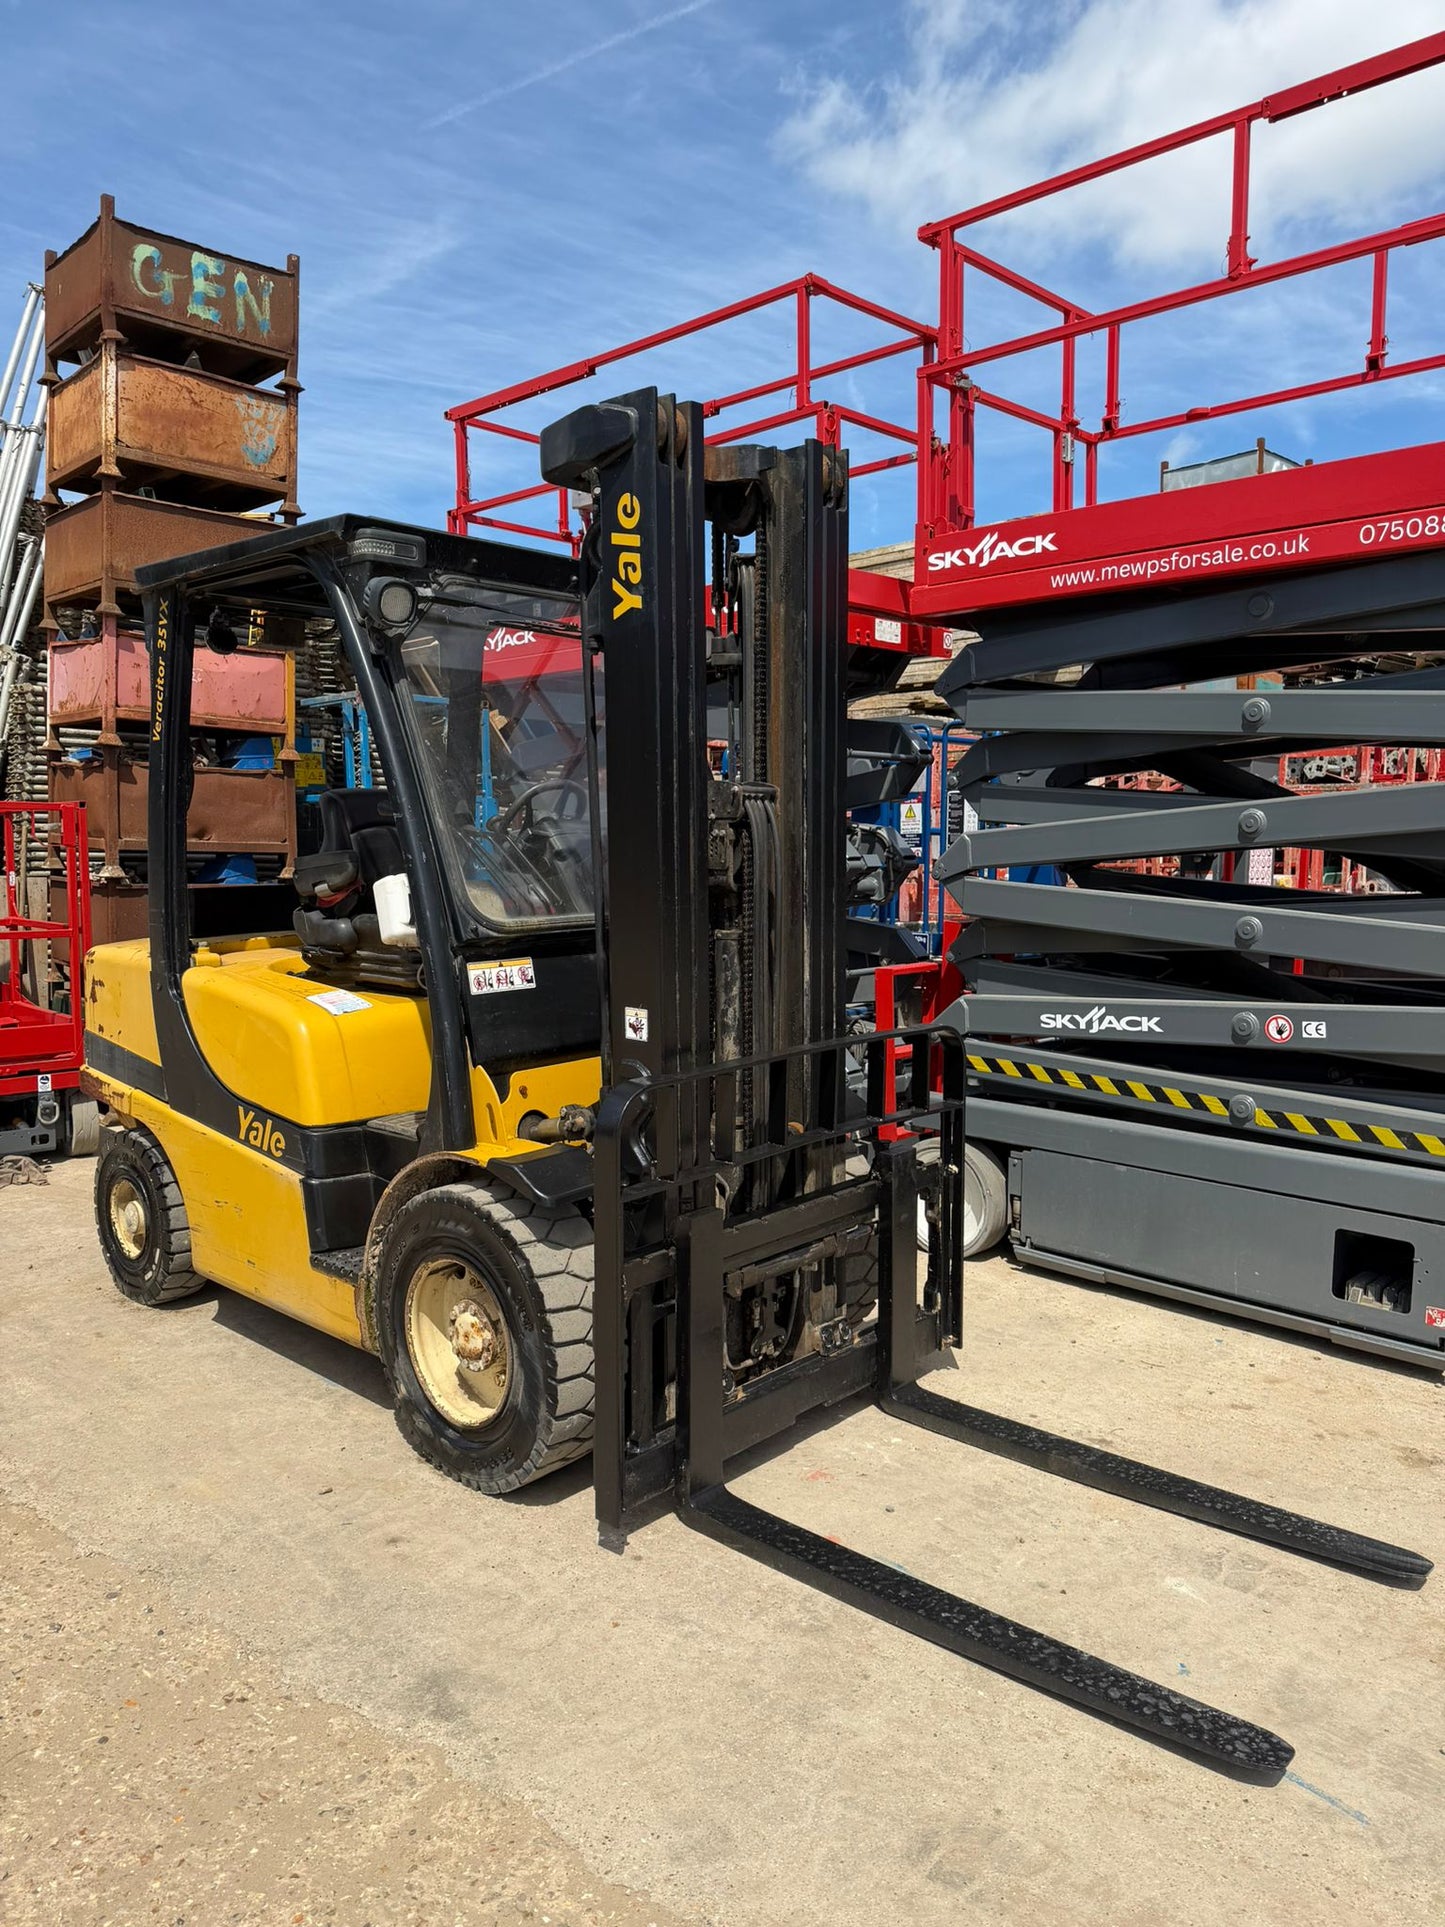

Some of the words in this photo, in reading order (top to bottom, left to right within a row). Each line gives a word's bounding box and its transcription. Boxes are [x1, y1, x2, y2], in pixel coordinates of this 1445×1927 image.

[130, 243, 274, 338] GEN
[610, 491, 643, 621] Yale
[928, 532, 1059, 571] SKYJACK
[1050, 533, 1310, 588] www.mewpsforsale.co.uk
[1358, 514, 1445, 545] 07508
[157, 597, 169, 651] 35VX
[152, 655, 167, 741] Veracitor
[1039, 1005, 1165, 1034] SKYJACK
[1303, 1022, 1325, 1037] CE
[237, 1105, 286, 1158] Yale
